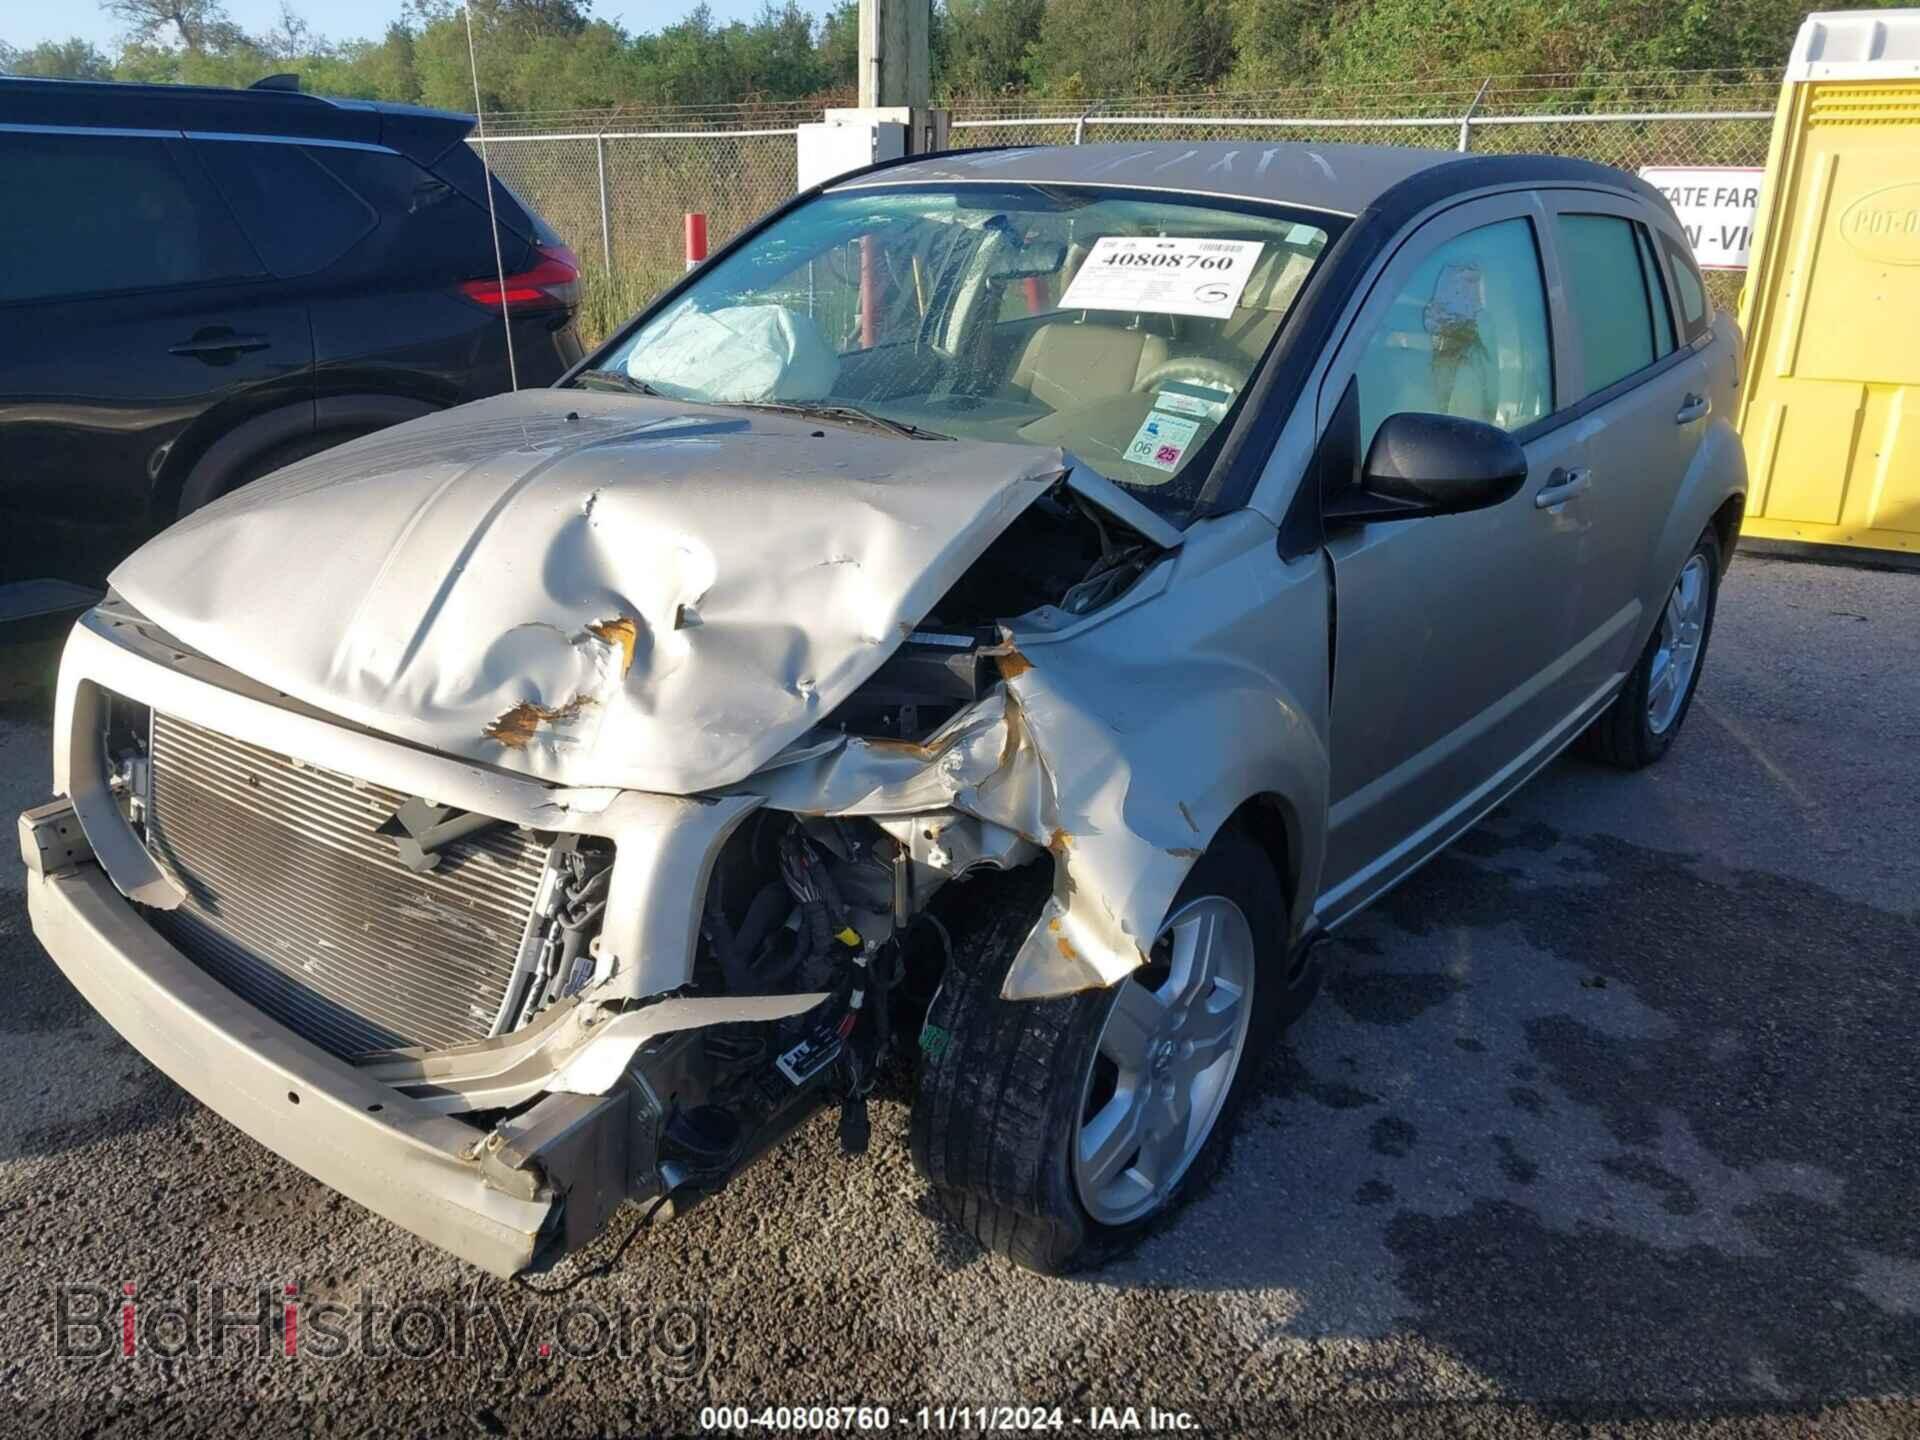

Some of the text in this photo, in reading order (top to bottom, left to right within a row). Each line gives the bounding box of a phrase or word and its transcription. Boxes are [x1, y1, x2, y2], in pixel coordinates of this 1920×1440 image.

[1656, 187, 1760, 208] TATE FAR
[1102, 252, 1233, 271] 40808760
[1134, 441, 1177, 462] 06 25
